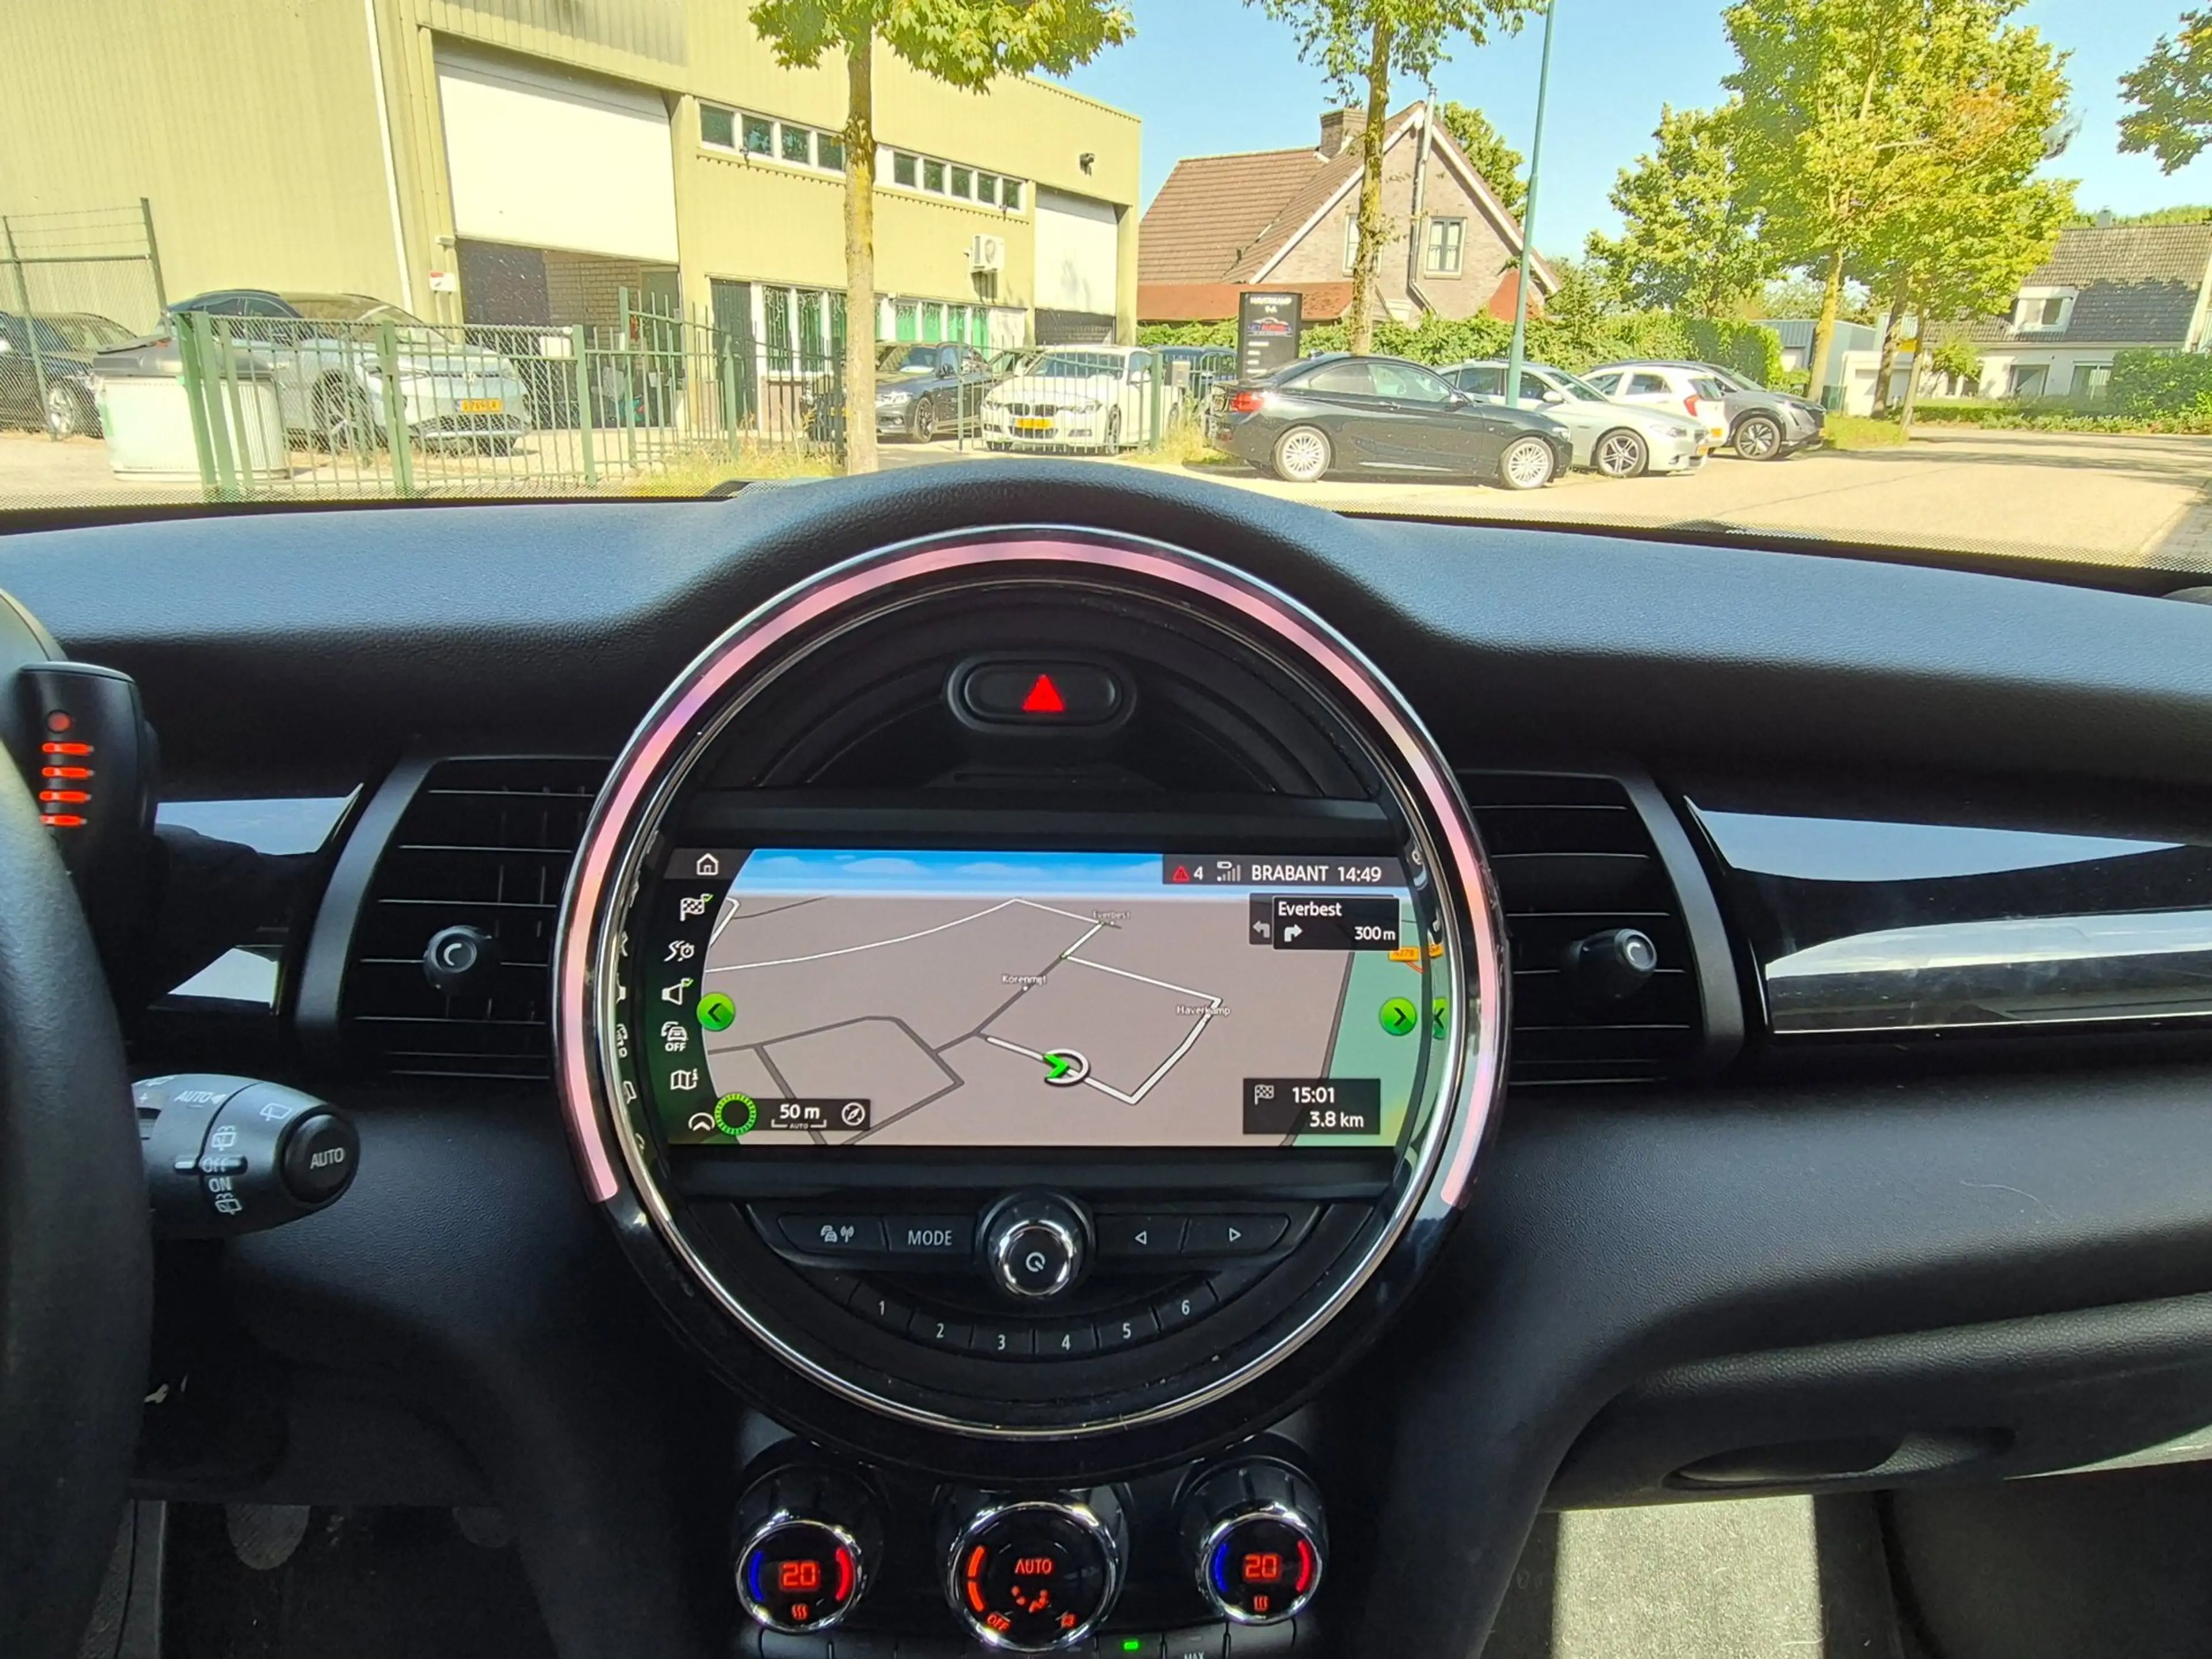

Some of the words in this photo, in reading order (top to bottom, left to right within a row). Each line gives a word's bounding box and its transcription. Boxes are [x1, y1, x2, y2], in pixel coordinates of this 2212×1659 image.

[1194, 866, 1203, 880] 4
[1252, 865, 1329, 881] BRABANT
[1338, 866, 1381, 882] 14:49
[1278, 901, 1342, 916] Everbest
[1354, 926, 1381, 940] 300
[1383, 930, 1396, 941] m
[1177, 1005, 1230, 1016] Haverkamp
[665, 1042, 686, 1052] OFF
[174, 1090, 213, 1103] AUTO
[1292, 1086, 1335, 1103] 15:01
[779, 1104, 801, 1119] 50
[804, 1107, 820, 1119] m
[1310, 1111, 1336, 1127] 3.8
[1340, 1112, 1364, 1127] km
[203, 1157, 228, 1172] OFF
[310, 1147, 345, 1169] AUTO
[209, 1176, 232, 1192] ON
[908, 1230, 952, 1245] MODE
[879, 1301, 885, 1315] 1
[1181, 1300, 1190, 1315] 6
[937, 1323, 945, 1338] 2
[1123, 1323, 1131, 1338] 5
[998, 1335, 1006, 1350] 3
[1062, 1335, 1071, 1350] 4
[783, 1561, 816, 1586] 20
[1014, 1558, 1052, 1574] AUTO
[1245, 1554, 1277, 1578] 20
[987, 1613, 1009, 1631] OFF
